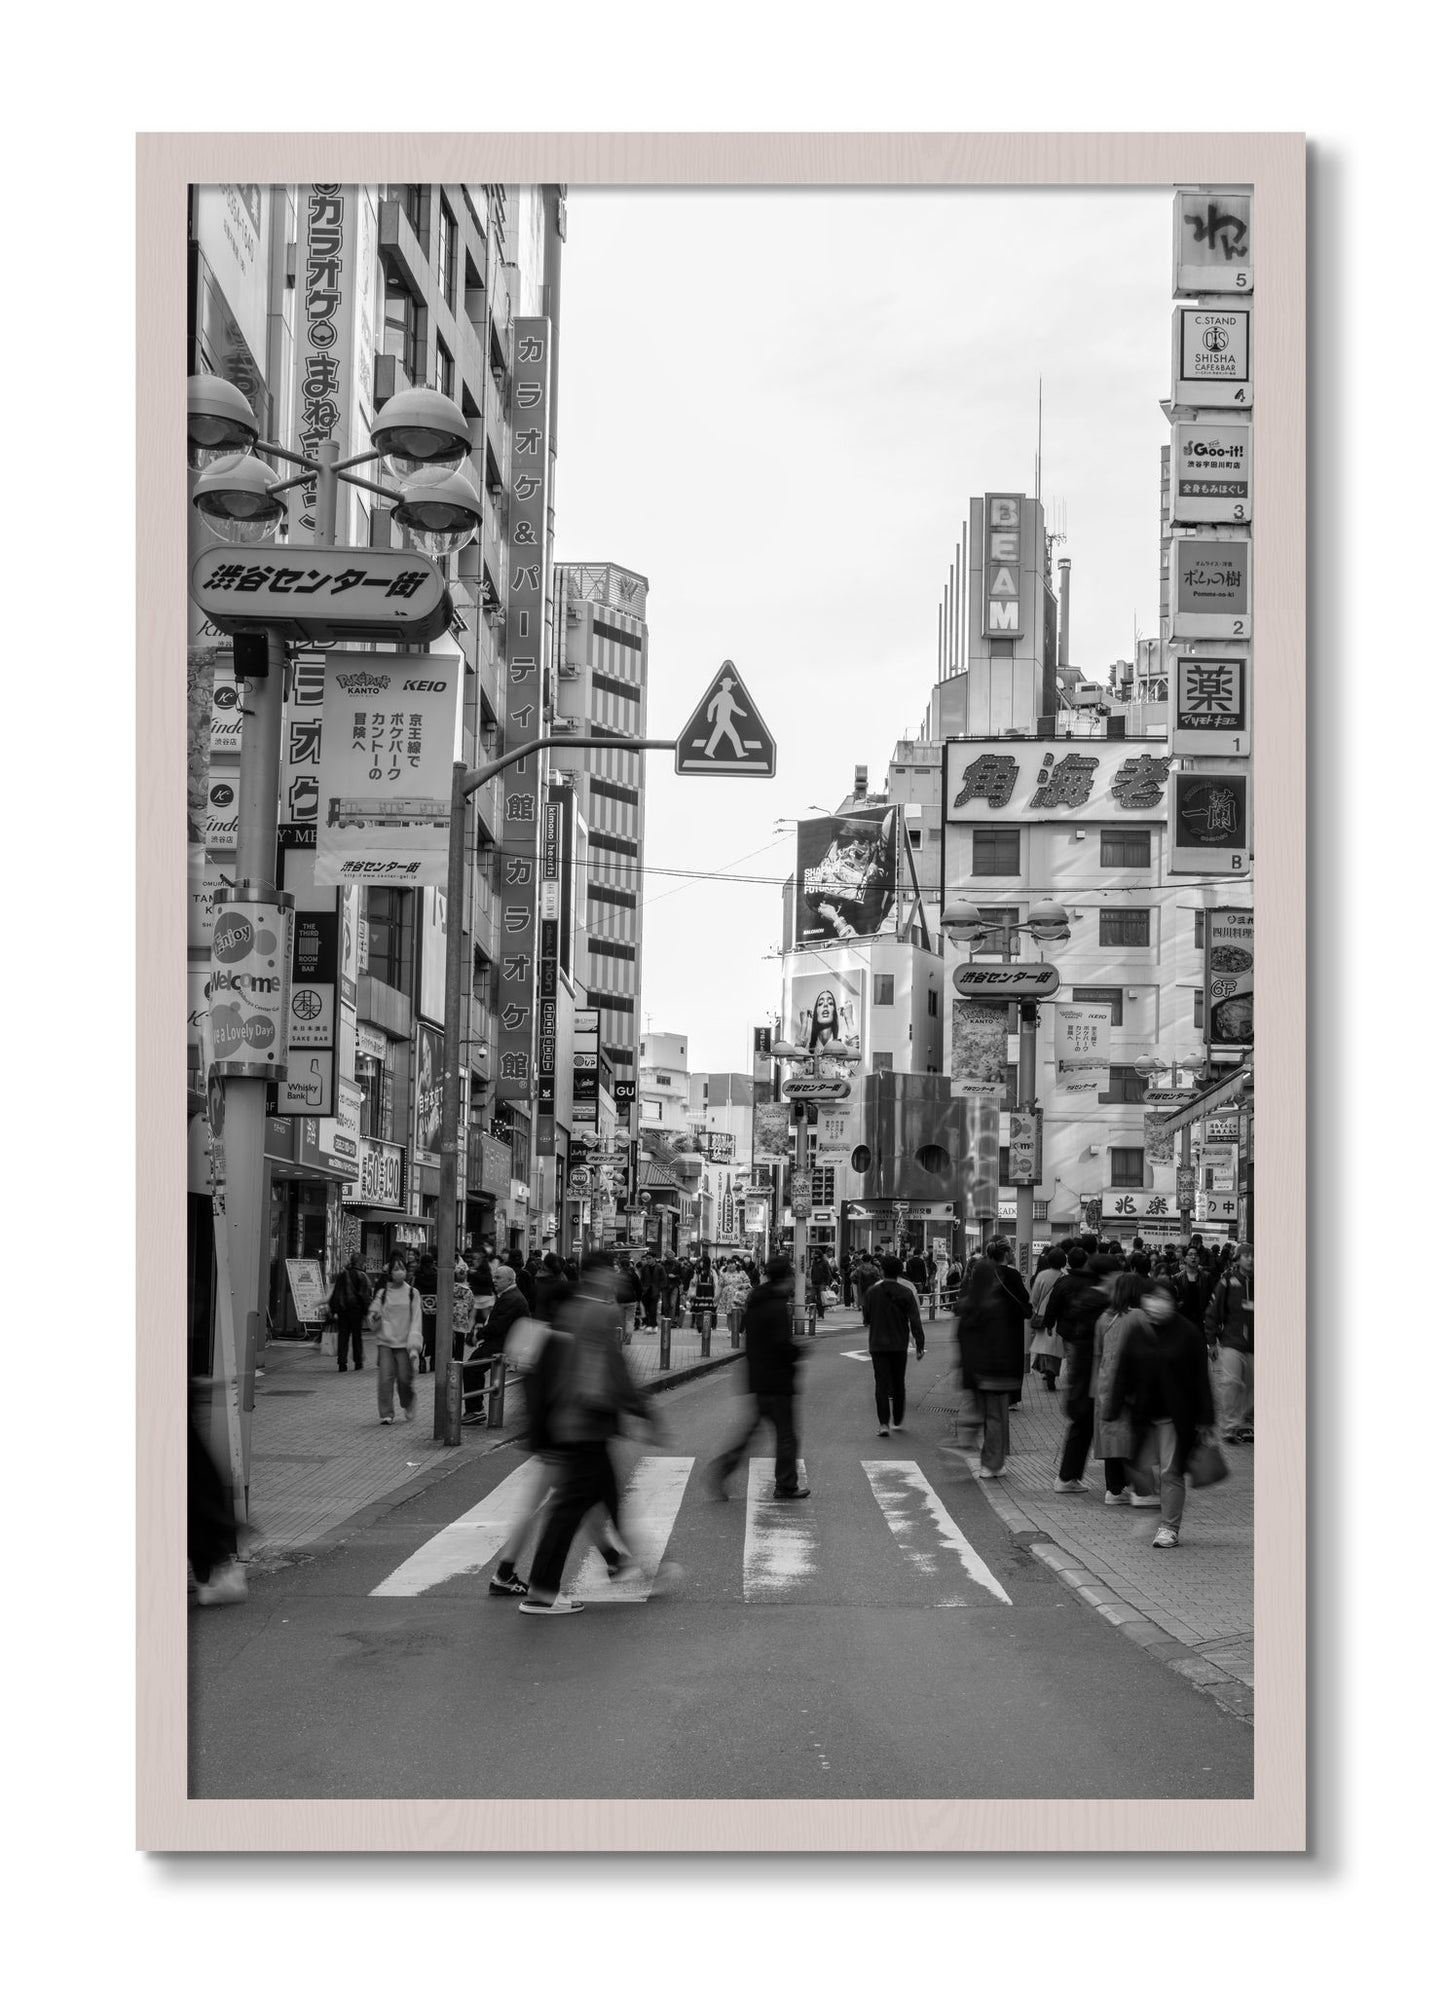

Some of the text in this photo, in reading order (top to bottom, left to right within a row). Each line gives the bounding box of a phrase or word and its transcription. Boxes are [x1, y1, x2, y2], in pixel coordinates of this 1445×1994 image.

[306, 196, 344, 319] カラオケ
[1236, 273, 1247, 287] 5
[1195, 316, 1236, 325] C.STAND
[1195, 354, 1236, 363] SHISHA
[1234, 389, 1245, 402] 4
[1194, 443, 1243, 457] Goo-it!
[1233, 505, 1244, 519] 3
[989, 498, 1019, 630] BEAM
[203, 564, 430, 598] 渋谷センター街
[1233, 621, 1243, 635] 2
[403, 680, 447, 692] KEIO
[1187, 665, 1232, 711] 薬
[352, 712, 366, 752] 冒険へ
[214, 738, 237, 746] 渋谷店
[369, 713, 385, 780] カントーの
[407, 714, 422, 768] 京王線で
[1233, 738, 1240, 751] 1
[547, 807, 556, 840] kimono
[210, 836, 233, 844] 渋谷店
[340, 861, 421, 873] 渋谷センター街
[1231, 855, 1242, 869] B
[214, 924, 250, 956] Enjoy
[500, 859, 533, 1080] カラオケ館
[211, 970, 280, 993] Welcome
[960, 971, 1053, 983] 渋谷センター街
[1211, 980, 1237, 998] 6F
[227, 1024, 254, 1040] Lovely
[255, 1024, 274, 1037] Day!
[288, 1083, 318, 1093] Whisky
[616, 1086, 634, 1096] GU
[785, 1083, 842, 1092] 渋谷センター街
[1115, 1196, 1168, 1215] 兆楽
